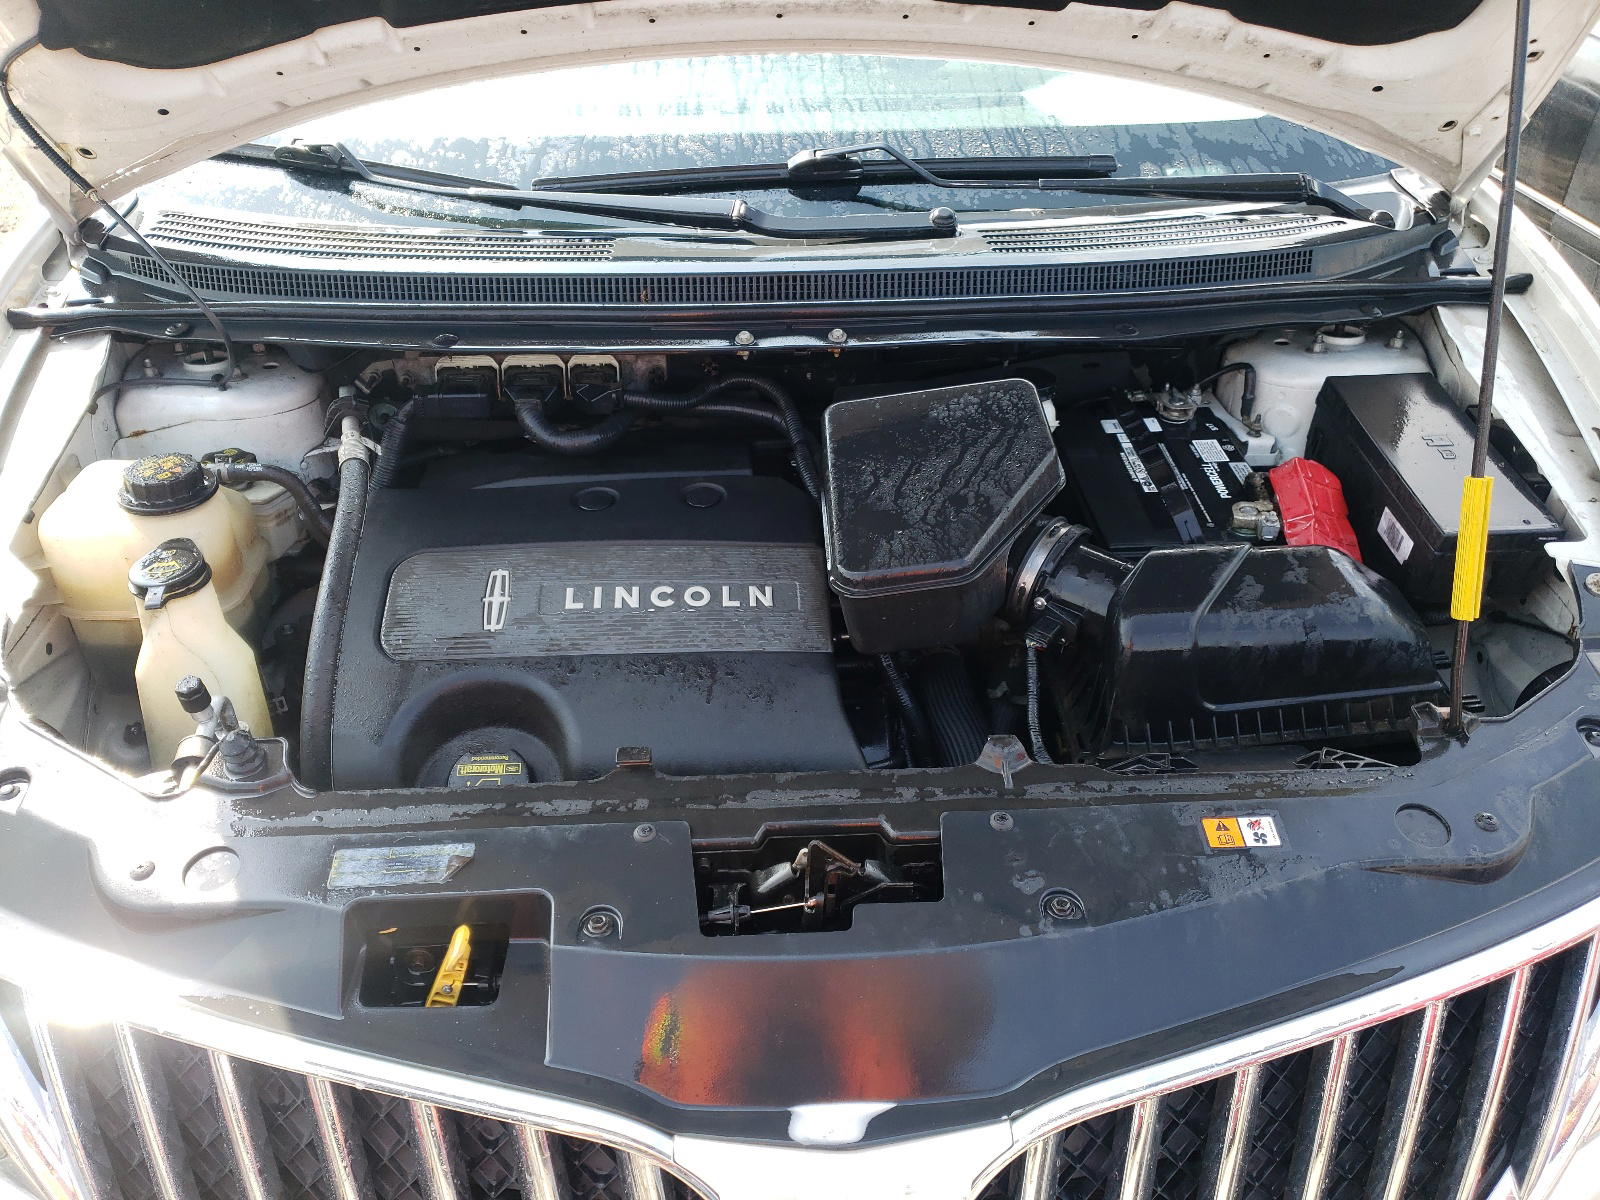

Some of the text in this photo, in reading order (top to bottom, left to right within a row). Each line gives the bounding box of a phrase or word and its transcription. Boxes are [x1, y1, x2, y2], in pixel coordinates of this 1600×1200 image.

[1201, 462, 1232, 499] POWERCELL
[565, 585, 774, 610] LINCOLN
[459, 763, 504, 775] Motorcraft
